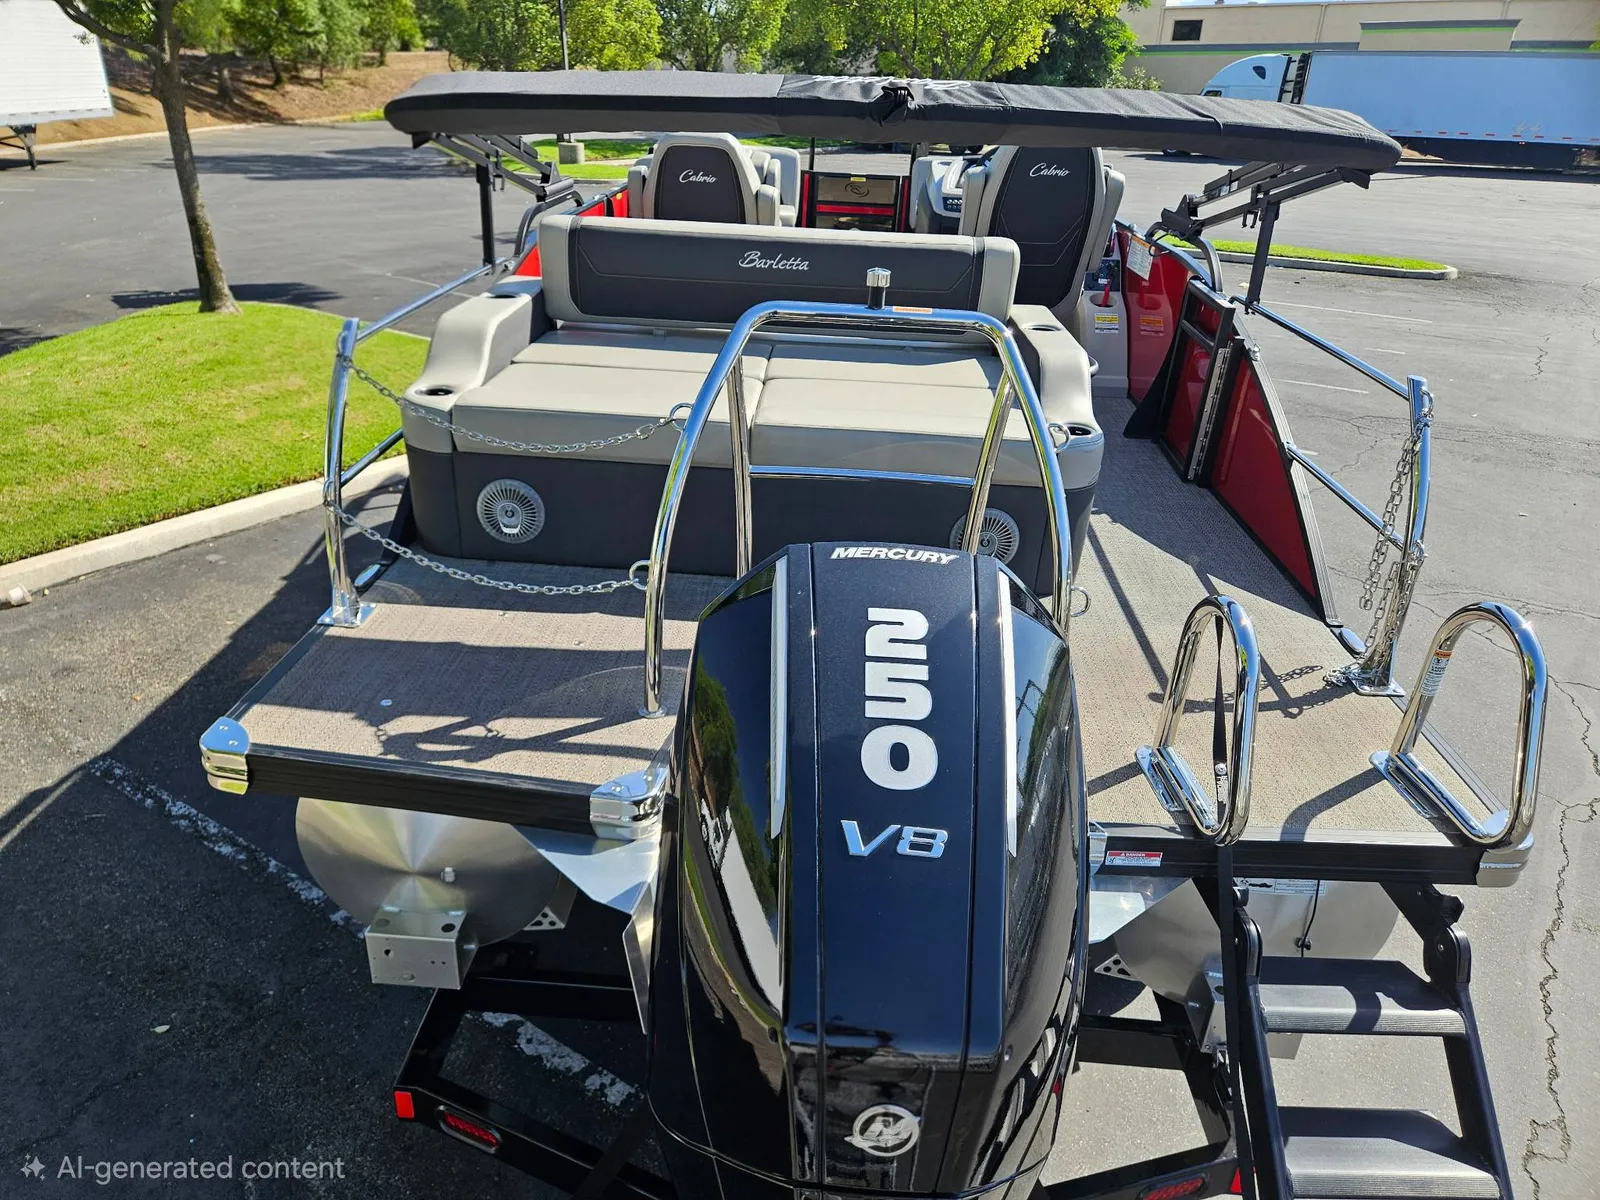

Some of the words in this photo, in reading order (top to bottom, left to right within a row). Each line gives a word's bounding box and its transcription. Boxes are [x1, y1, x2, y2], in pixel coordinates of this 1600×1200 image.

[679, 169, 717, 183] Cabrio
[1029, 162, 1070, 177] Cabrio
[738, 250, 810, 271] Barletta
[830, 547, 960, 564] MERCURY
[861, 608, 938, 790] 250
[840, 819, 949, 859] V8
